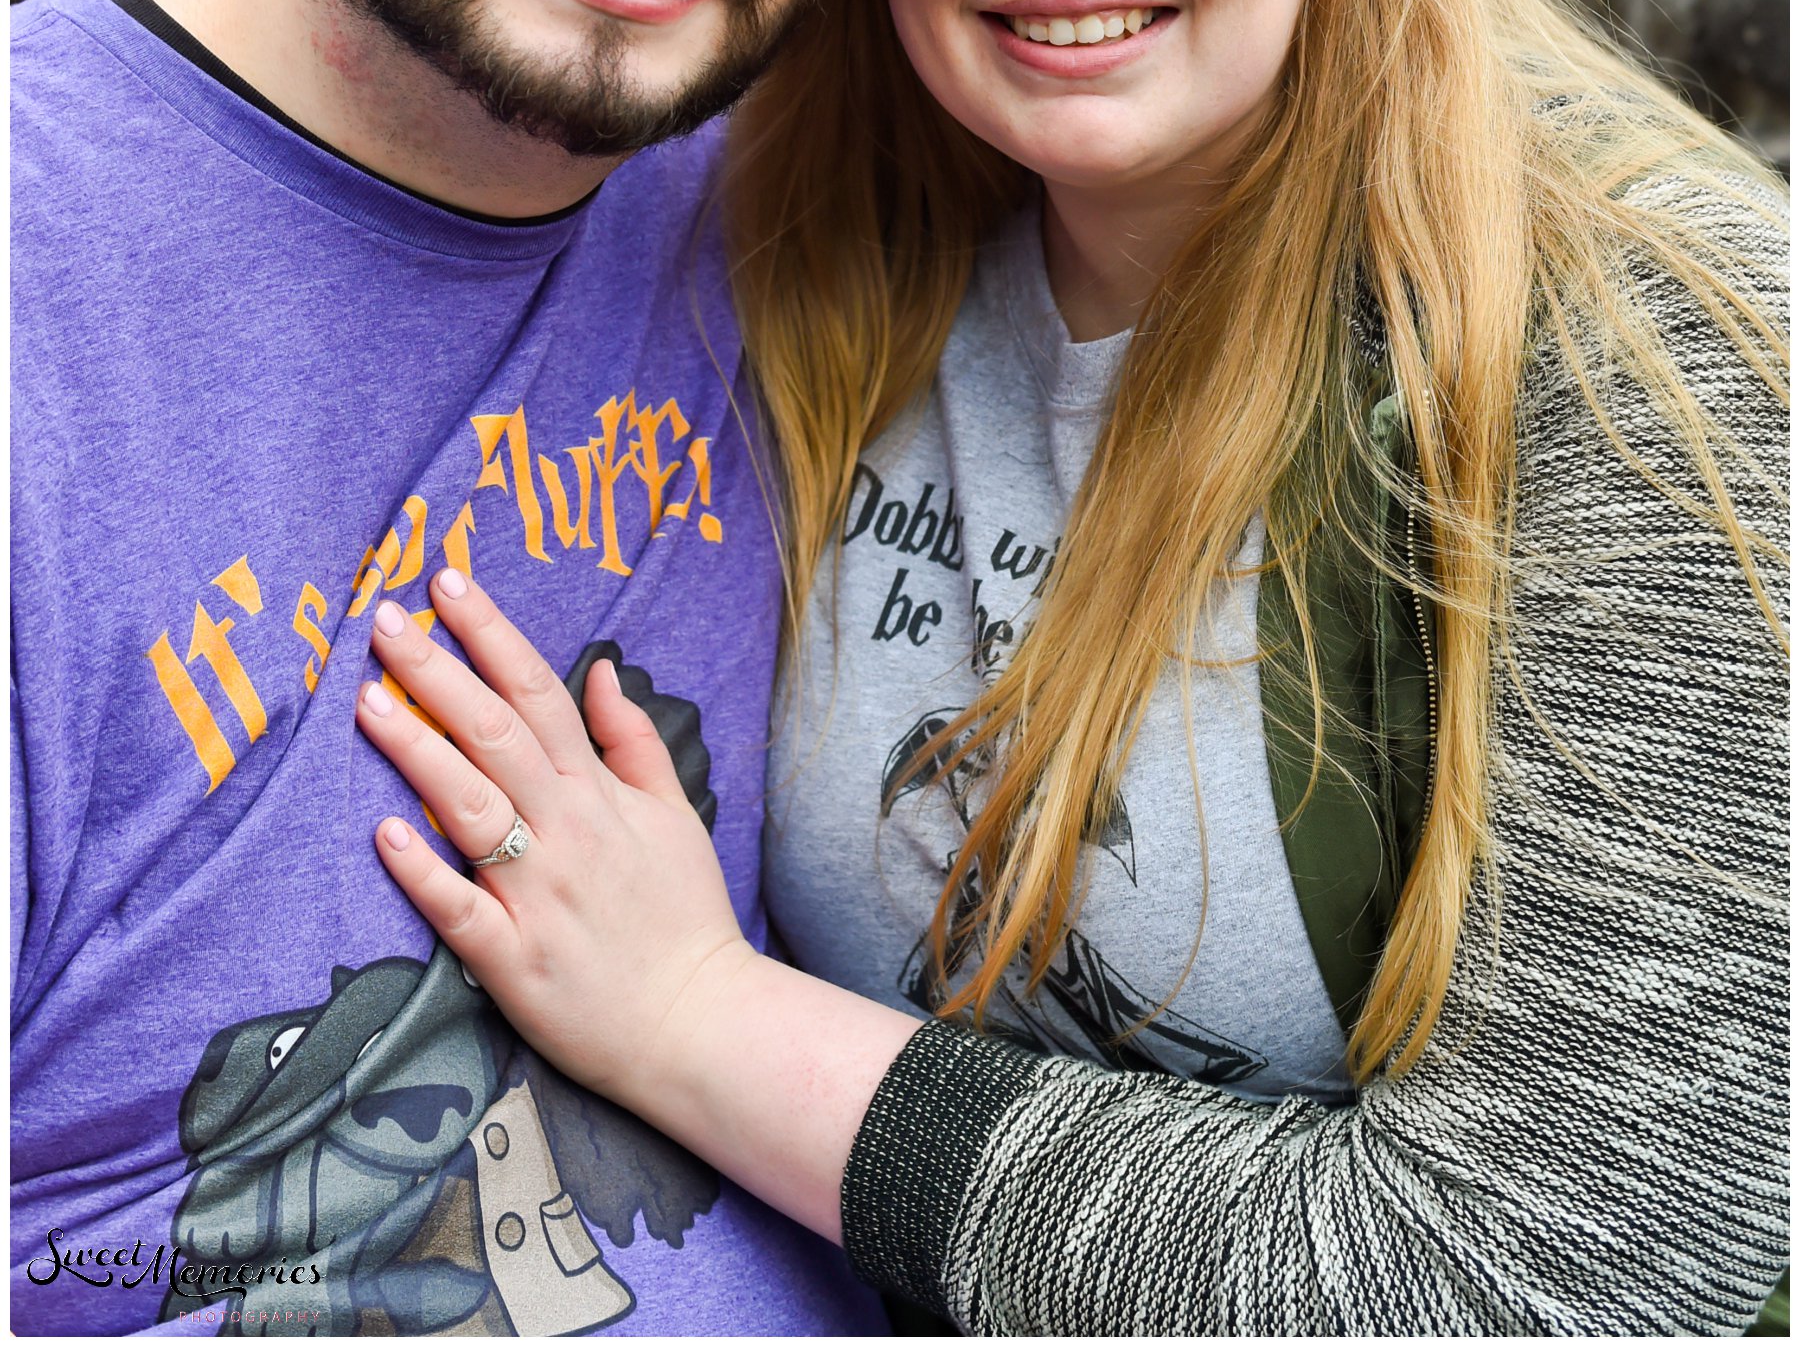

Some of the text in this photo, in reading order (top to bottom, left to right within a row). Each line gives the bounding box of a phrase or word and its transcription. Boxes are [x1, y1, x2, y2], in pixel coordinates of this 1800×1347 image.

[841, 460, 965, 572] Dobb
[871, 567, 943, 647] be
[146, 554, 331, 798] It's
